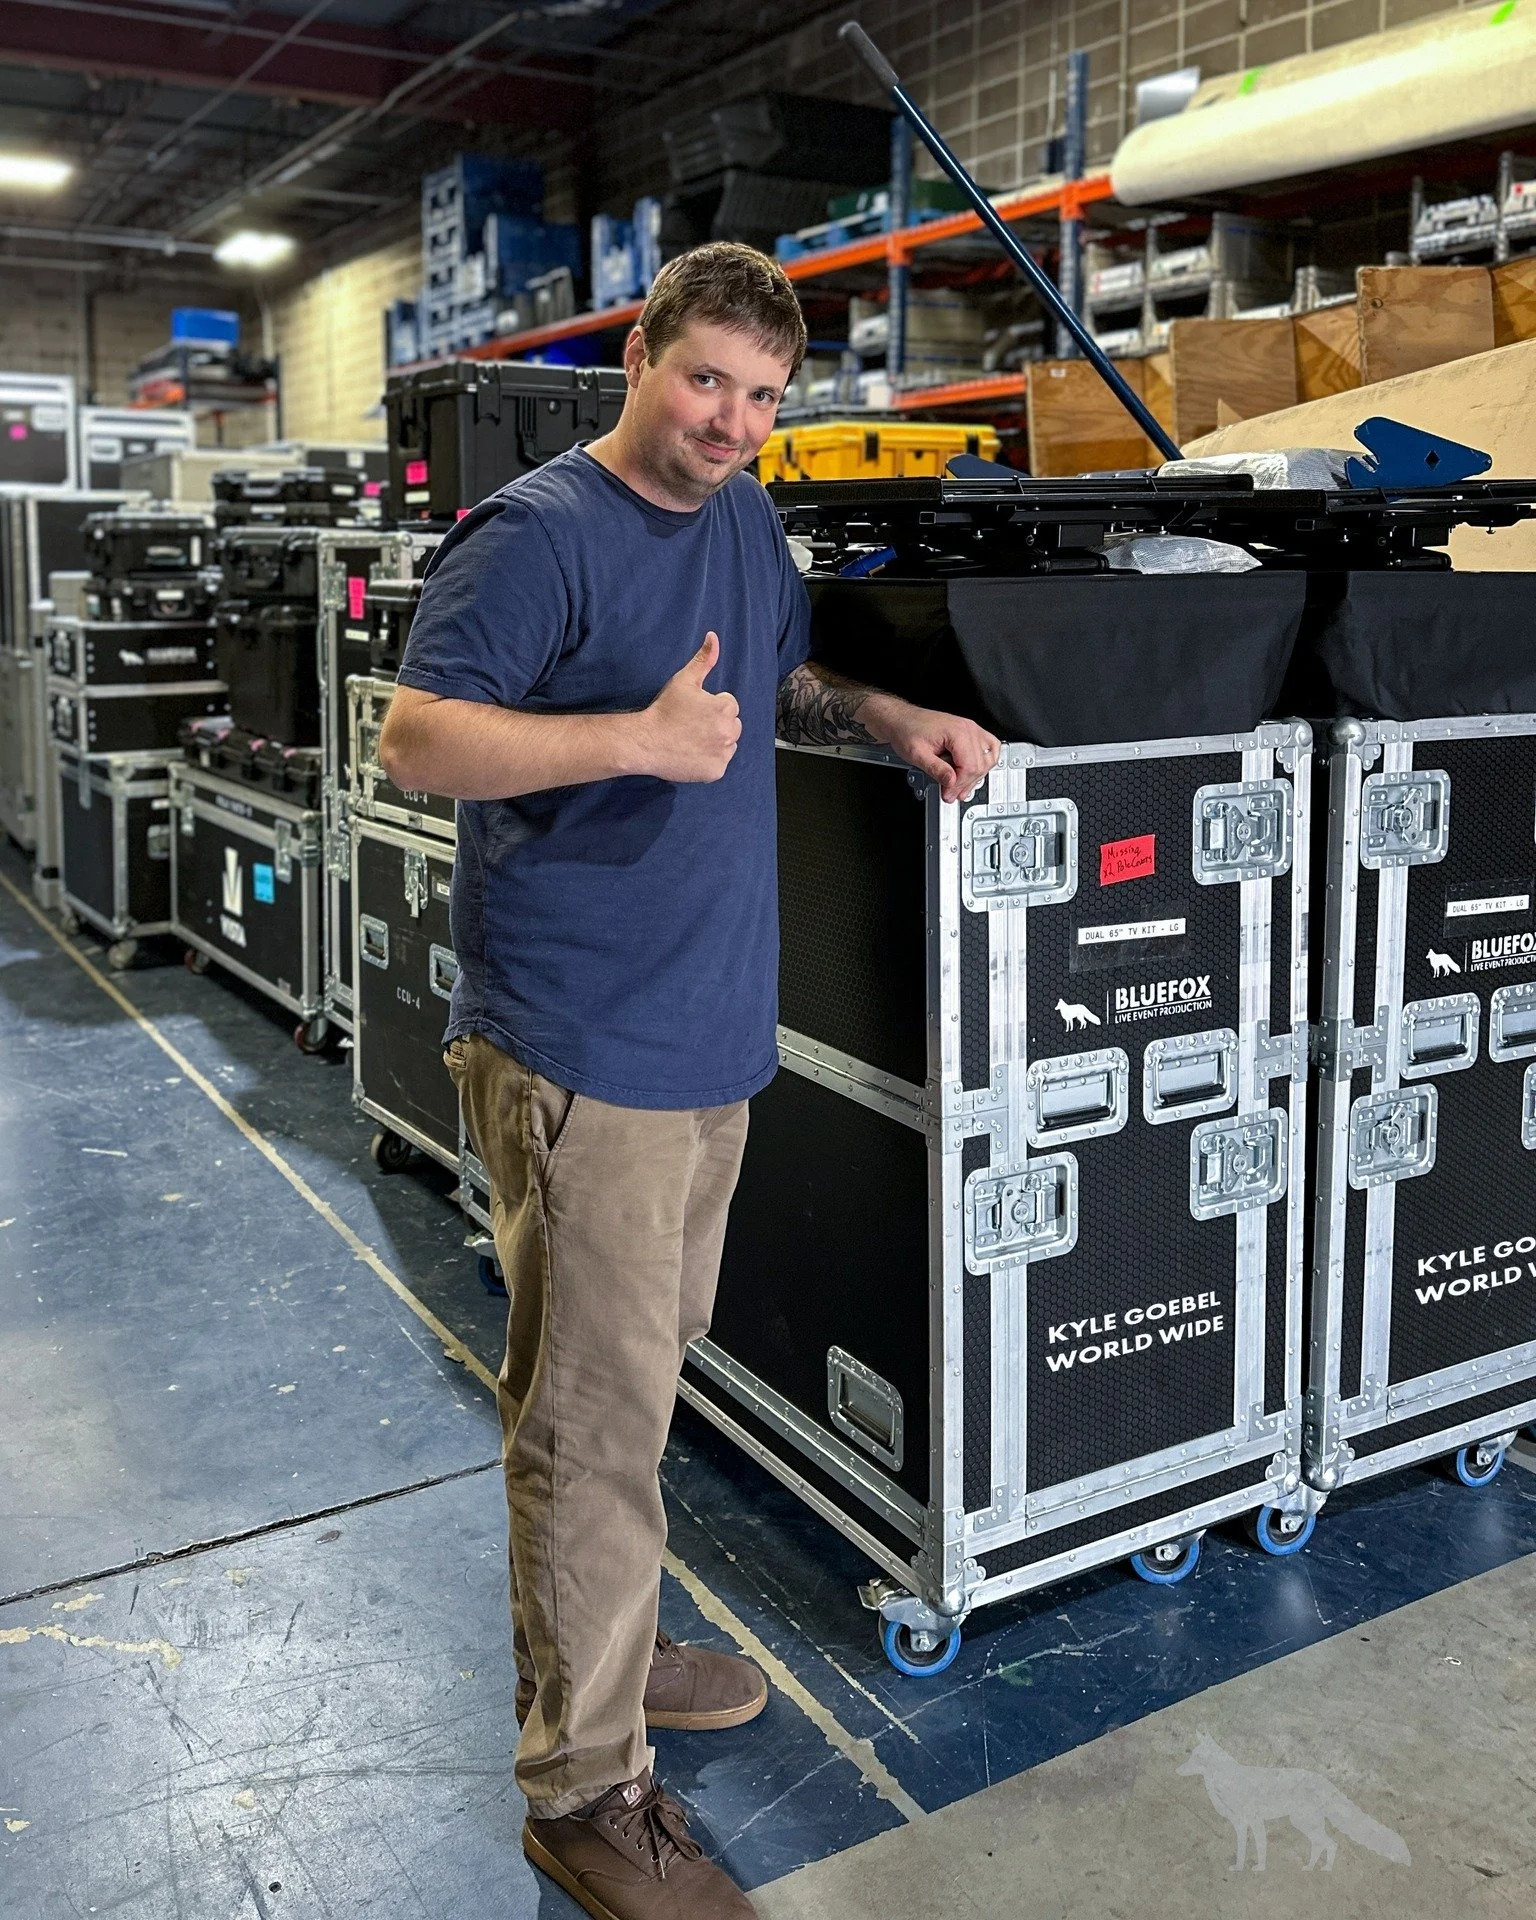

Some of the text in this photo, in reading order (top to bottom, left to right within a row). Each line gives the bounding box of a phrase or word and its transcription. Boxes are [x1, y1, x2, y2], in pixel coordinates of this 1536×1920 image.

[1107, 845, 1141, 859] Missing
[1452, 905, 1467, 913] DUAL
[1495, 901, 1507, 909] KIT
[1516, 899, 1524, 907] LG
[1085, 931, 1105, 940] DUAL
[1109, 928, 1124, 938] 65"
[1128, 927, 1138, 936] TV
[1142, 925, 1156, 934] KIT
[1169, 923, 1179, 932] LG
[1470, 955, 1536, 972] LIVE EVENT PRODUCTI
[396, 986, 420, 1010] CCU-4
[1115, 974, 1212, 1010] BLUEFOX
[1115, 999, 1213, 1024] LIVE EVENT PRODUCTION
[1417, 1236, 1536, 1277] KYLE GO
[1414, 1266, 1522, 1305] WORLD
[1048, 1290, 1221, 1344] KYLE GOEBEL
[1045, 1314, 1224, 1373] WORLD WIDE
